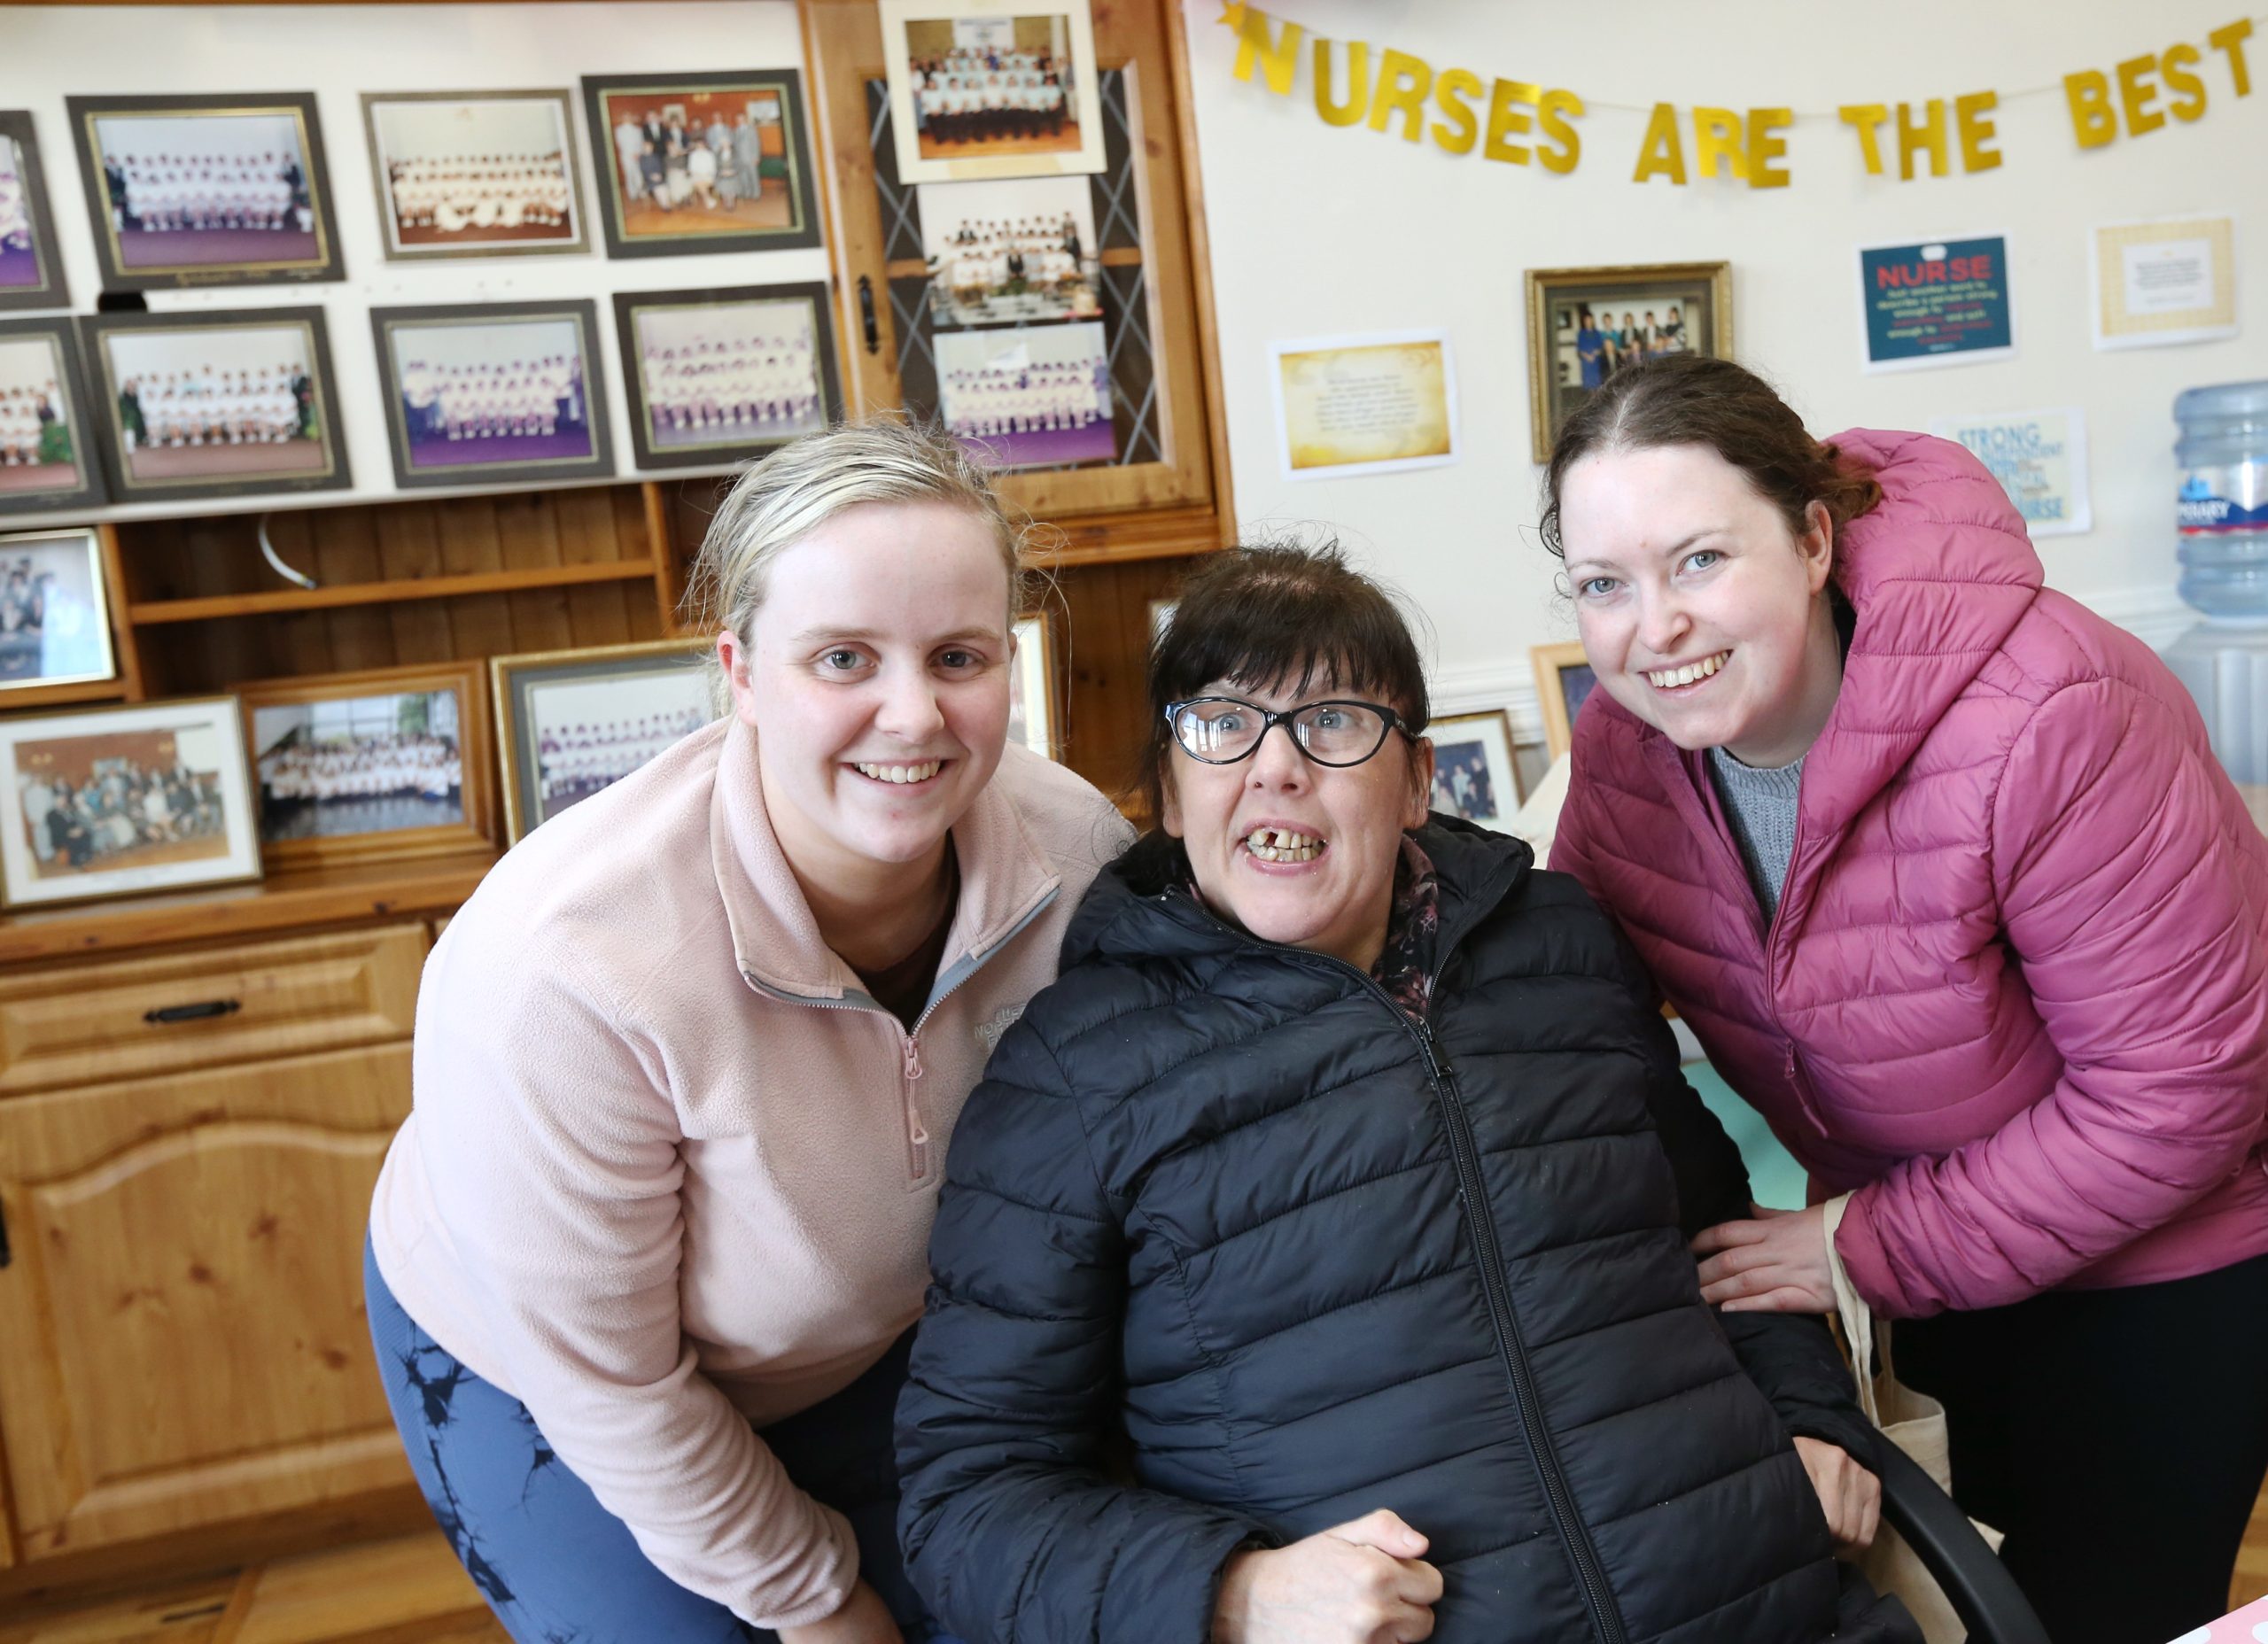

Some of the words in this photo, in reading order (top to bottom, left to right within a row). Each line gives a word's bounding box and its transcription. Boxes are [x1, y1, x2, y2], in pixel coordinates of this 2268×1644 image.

[1233, 7, 1585, 174] NURSES
[1632, 103, 1792, 189] ARE
[1838, 90, 2002, 181] THE
[2062, 18, 2253, 150] BEST
[1876, 255, 1992, 290] NURSE
[975, 1017, 1014, 1040] NORT
